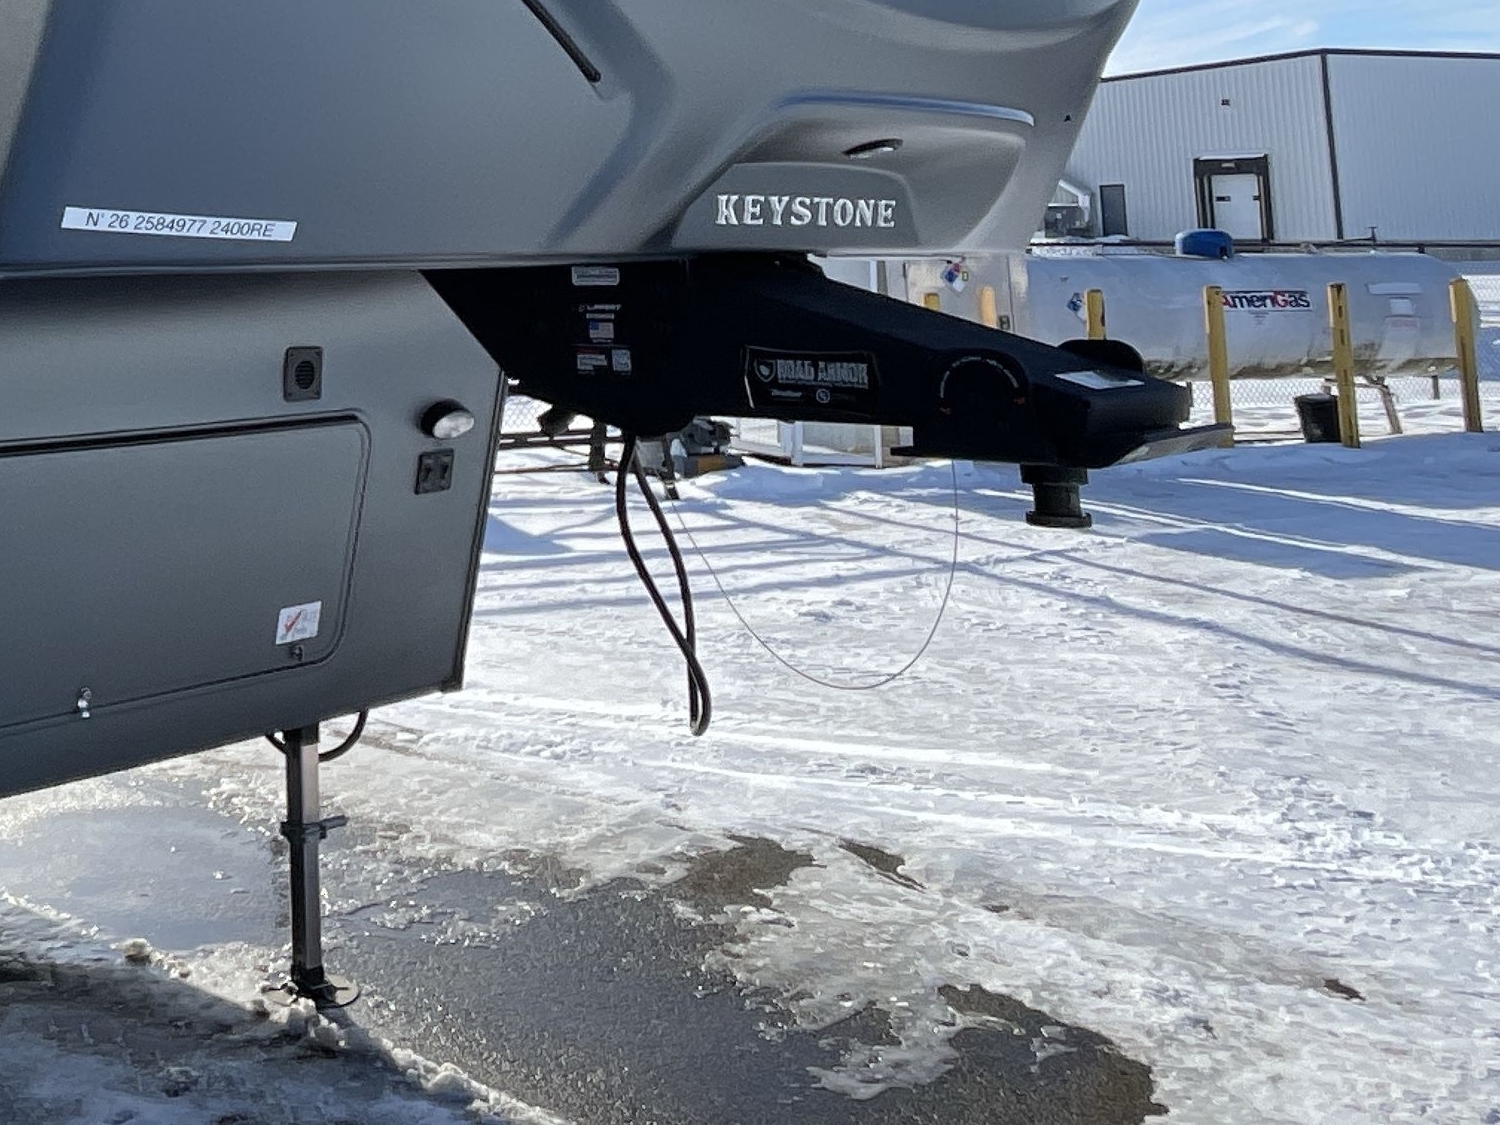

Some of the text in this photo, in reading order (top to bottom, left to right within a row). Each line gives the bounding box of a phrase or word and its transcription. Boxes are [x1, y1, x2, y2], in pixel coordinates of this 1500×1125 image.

[107, 213, 130, 229] 26
[134, 216, 207, 234] 2584977
[209, 220, 276, 238] 2400RE
[715, 194, 896, 228] KEYSTONE
